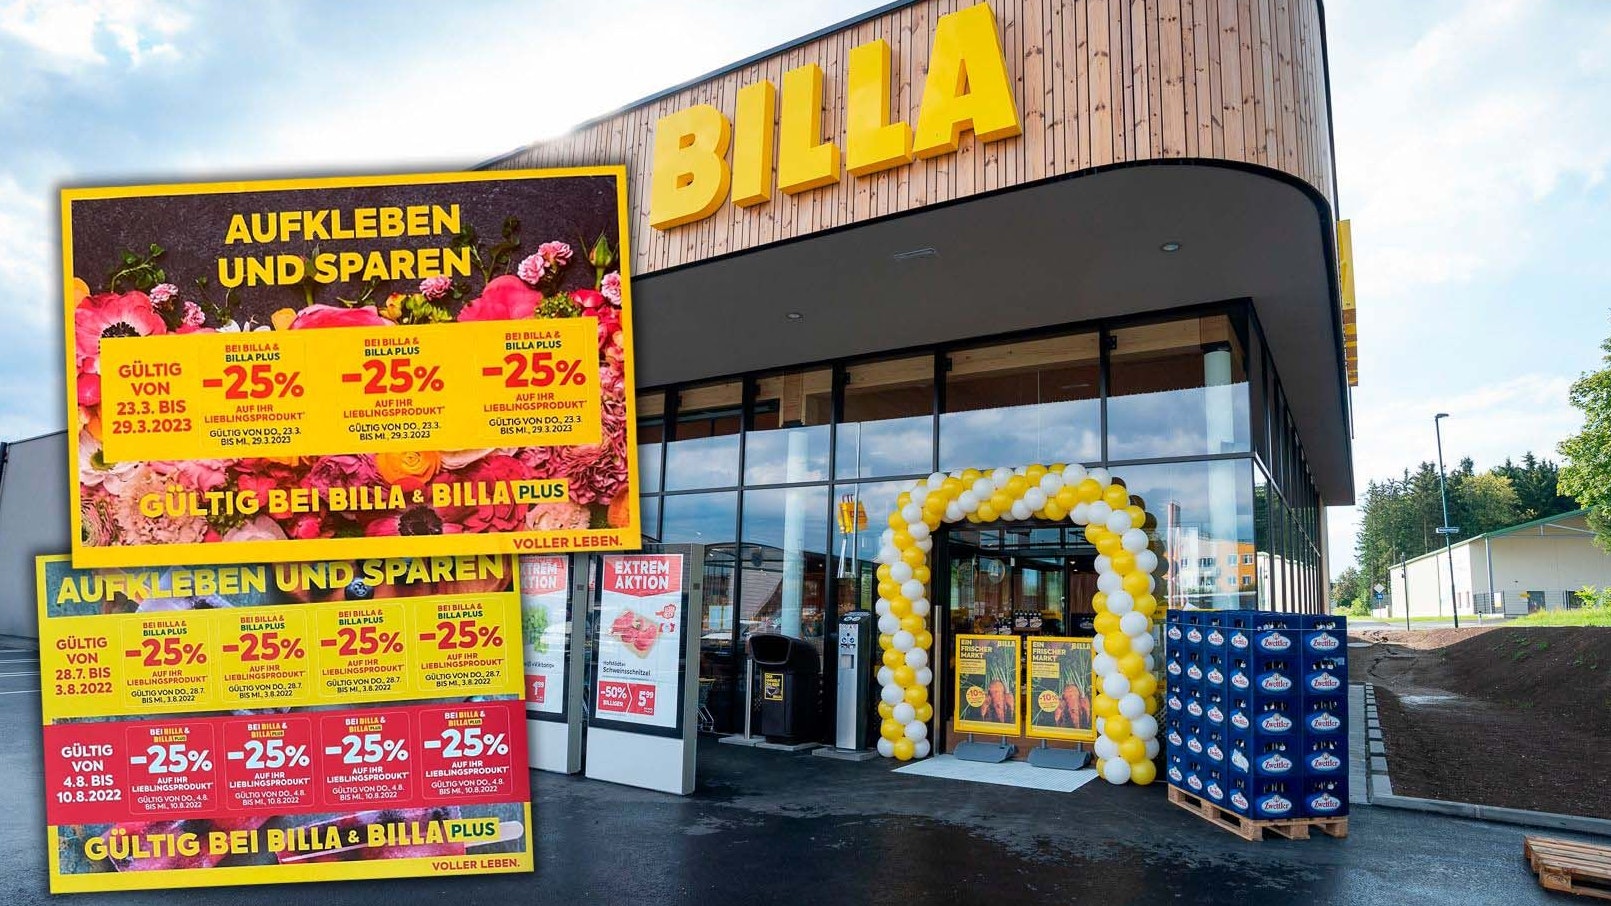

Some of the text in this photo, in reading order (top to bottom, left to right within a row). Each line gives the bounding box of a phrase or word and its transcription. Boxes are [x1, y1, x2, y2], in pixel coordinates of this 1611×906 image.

[650, 2, 1022, 230] BILLA
[615, 560, 670, 575] EXTREM
[615, 575, 669, 590] AKTION
[1263, 639, 1291, 648] Zwettler
[1313, 639, 1336, 647] Zwettler
[1264, 680, 1291, 688] Zwettler
[1314, 679, 1337, 688] Zwettler
[601, 686, 627, 699] -50%
[1264, 720, 1291, 729] Zwettler
[1314, 719, 1338, 728] Zwettler
[1264, 761, 1291, 770] Zwettler
[1314, 760, 1338, 768] Zwettler
[1264, 801, 1291, 810] Zwettler
[1314, 800, 1338, 809] Zwettler
